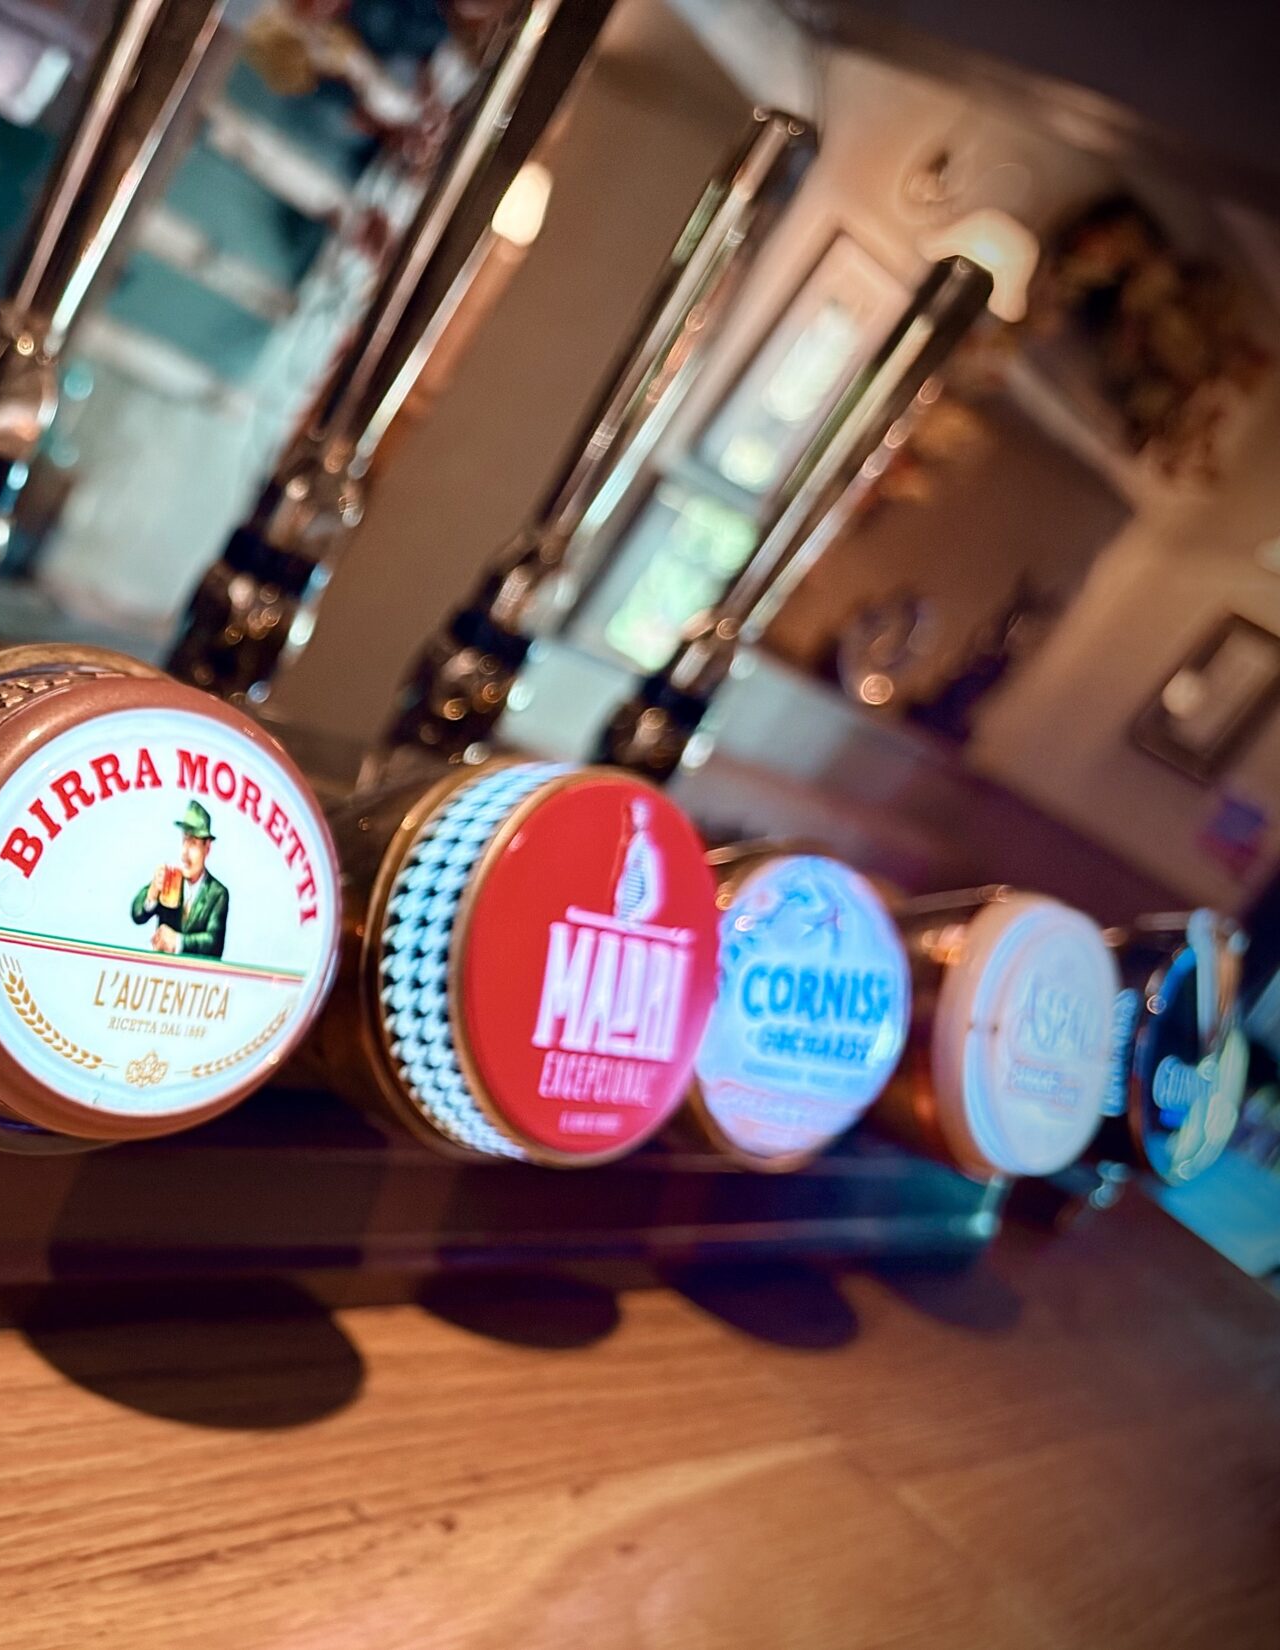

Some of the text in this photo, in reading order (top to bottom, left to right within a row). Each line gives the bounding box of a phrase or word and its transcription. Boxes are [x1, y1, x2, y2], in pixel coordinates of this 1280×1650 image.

[0, 747, 318, 926] BIRRA MORETTI
[93, 970, 232, 1022] L'AUTENTICA
[107, 1016, 158, 1034] RICETTA
[159, 1022, 181, 1037] DAL
